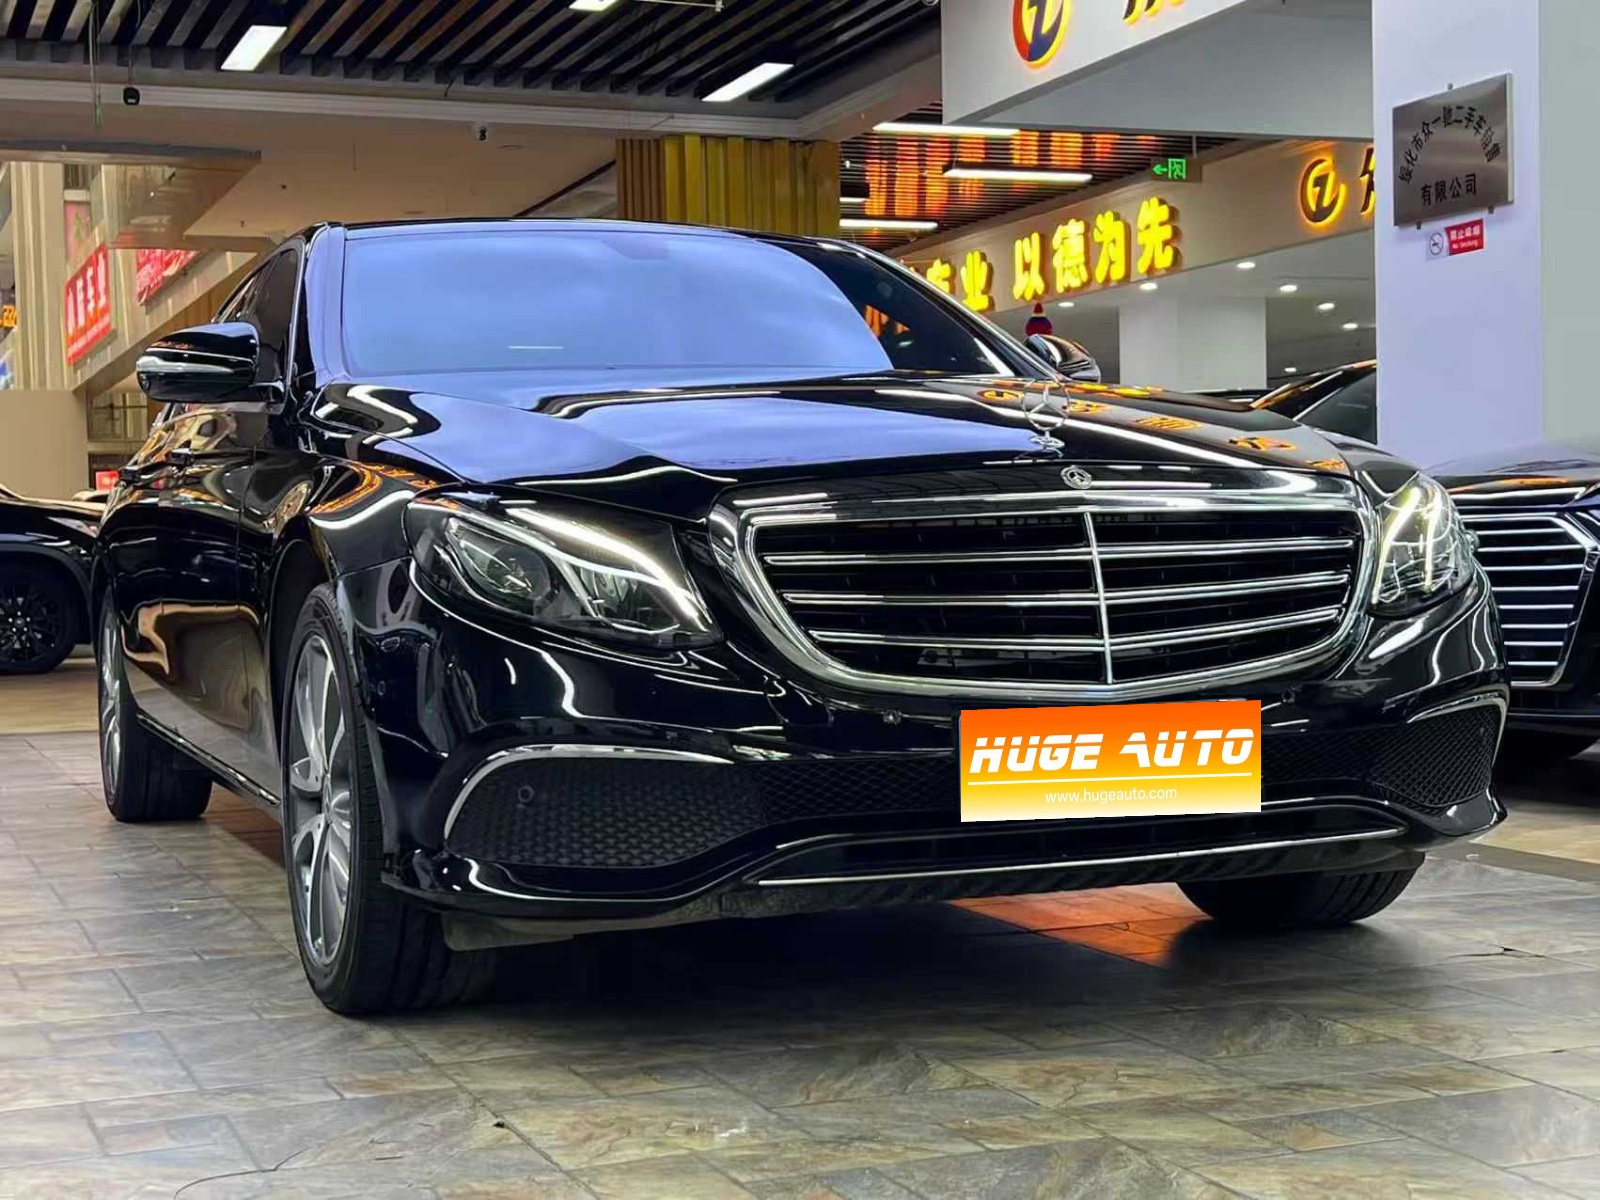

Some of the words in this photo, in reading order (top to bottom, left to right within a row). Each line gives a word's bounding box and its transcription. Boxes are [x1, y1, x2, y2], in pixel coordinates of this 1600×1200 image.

[1420, 172, 1477, 206] 有限公司
[1012, 196, 1174, 302] 以德为先
